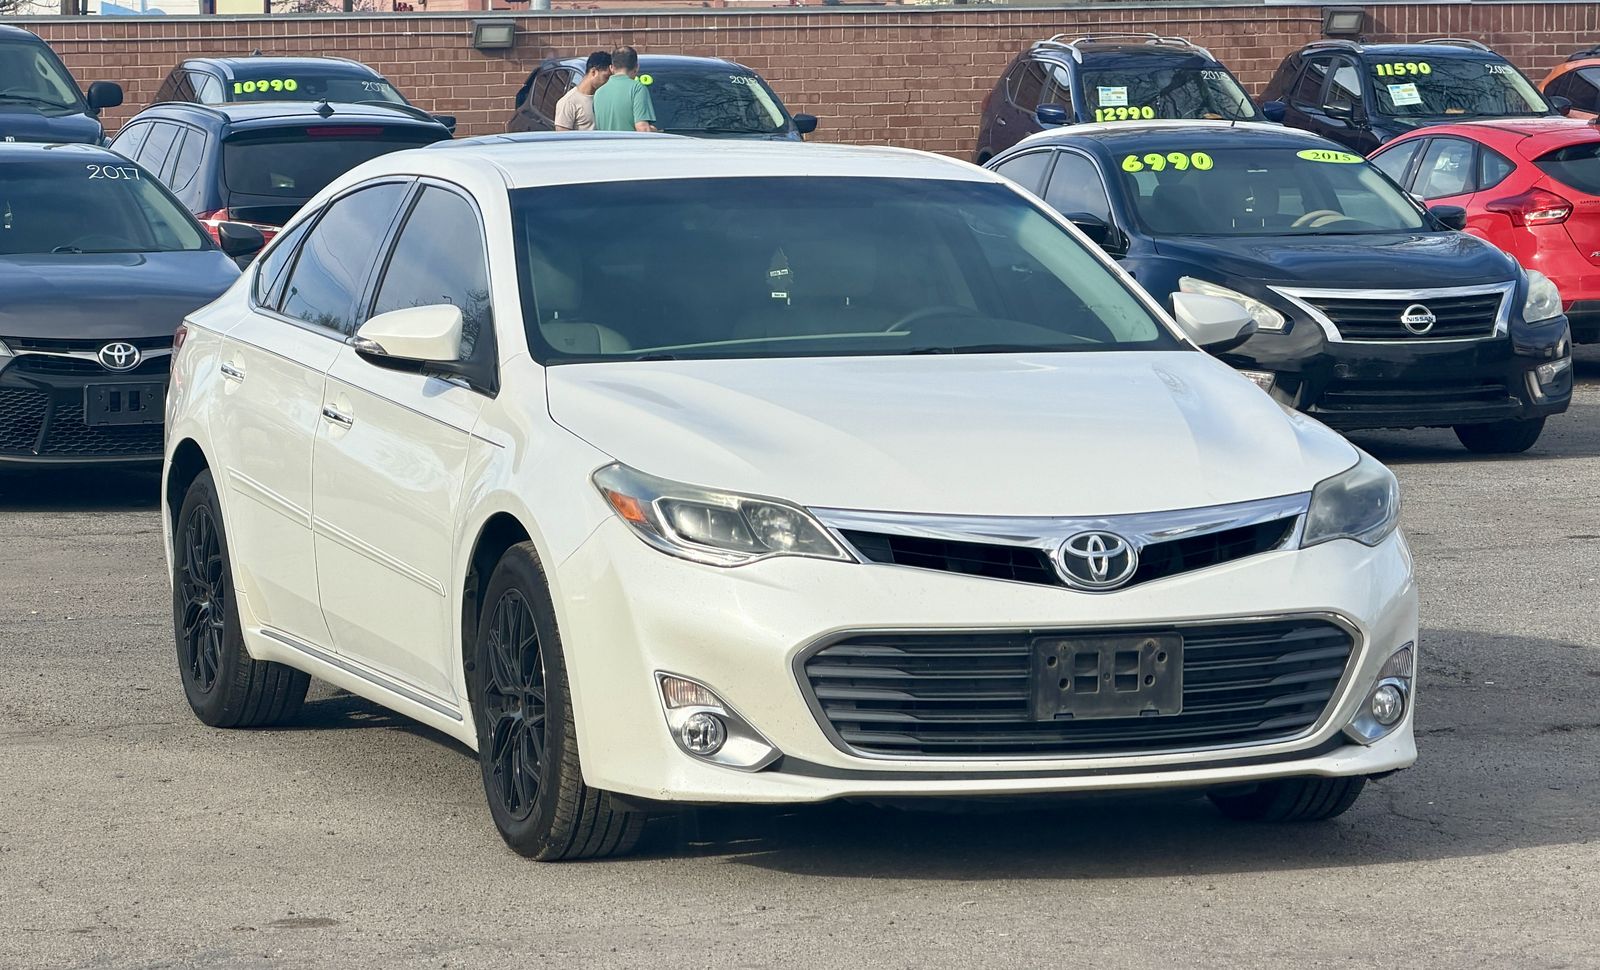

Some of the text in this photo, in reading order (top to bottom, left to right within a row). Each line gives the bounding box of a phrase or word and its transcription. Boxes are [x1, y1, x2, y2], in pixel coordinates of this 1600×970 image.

[1376, 62, 1431, 76] 11590
[234, 79, 298, 94] 10990
[1095, 105, 1155, 122] 12990
[1121, 152, 1214, 172] 6990
[1311, 151, 1351, 161] 2015
[86, 164, 140, 181] 2017
